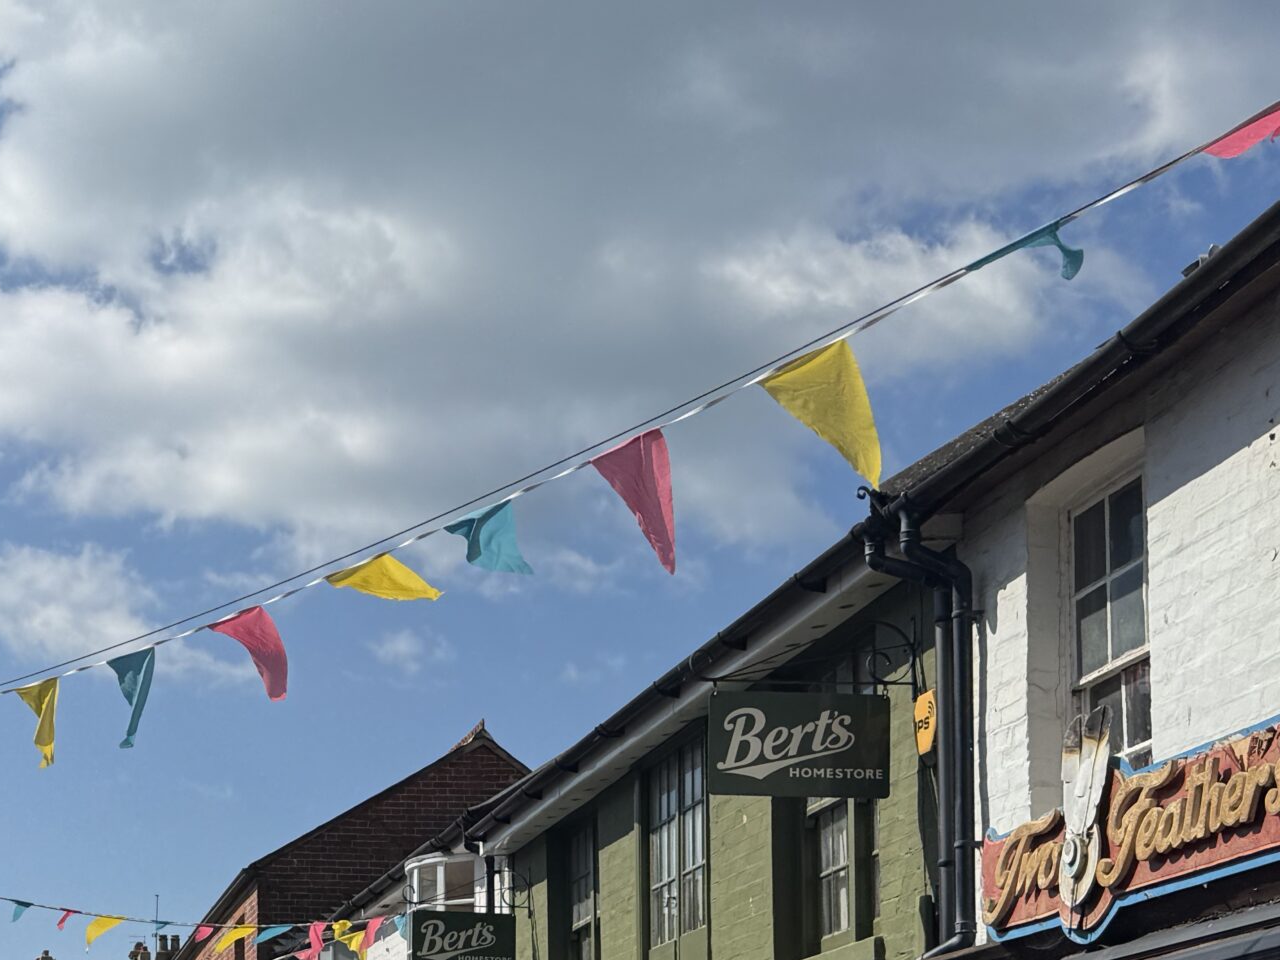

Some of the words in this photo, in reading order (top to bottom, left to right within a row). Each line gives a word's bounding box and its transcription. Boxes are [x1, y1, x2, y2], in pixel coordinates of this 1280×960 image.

[716, 706, 855, 774] Bert's
[789, 767, 884, 780] HOMESTORE
[982, 807, 1064, 925] Two
[416, 919, 496, 957] Bert's
